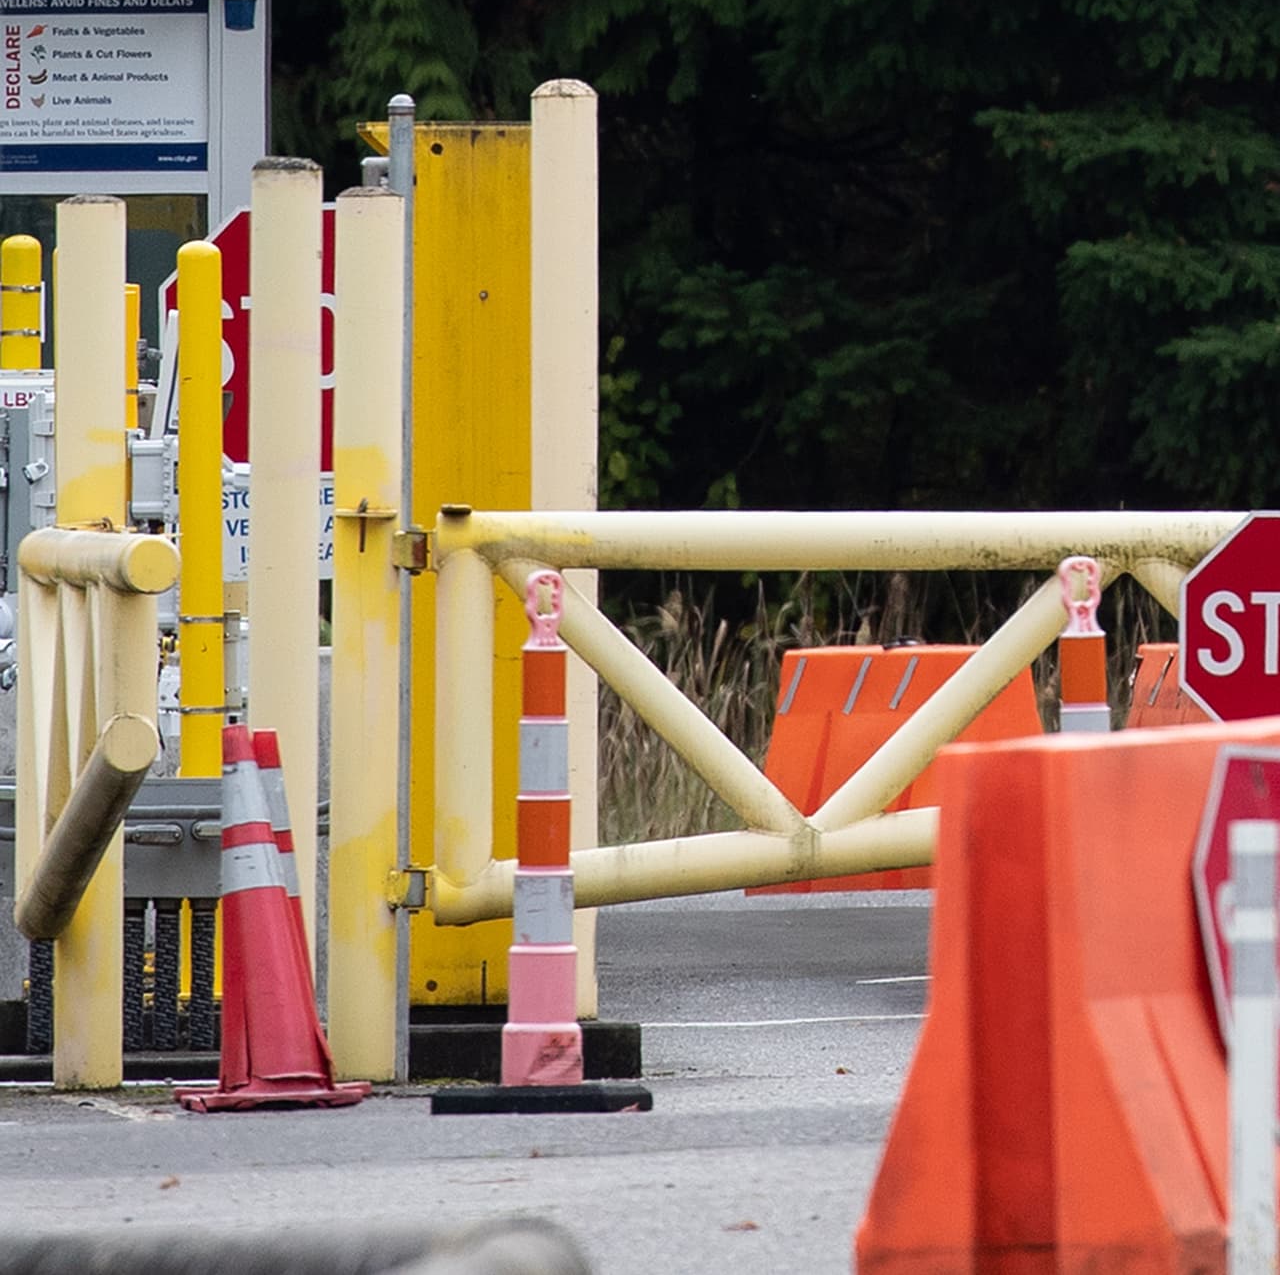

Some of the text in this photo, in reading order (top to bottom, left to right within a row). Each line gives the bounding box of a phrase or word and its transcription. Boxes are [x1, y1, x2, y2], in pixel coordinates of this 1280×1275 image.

[52, 26, 145, 38] Fruits & Vegetables
[52, 50, 152, 59] Plants & Cut Flowers
[6, 25, 21, 109] DECLARE
[52, 73, 168, 82] Meat & Animal Products
[52, 96, 112, 105] Live Animals
